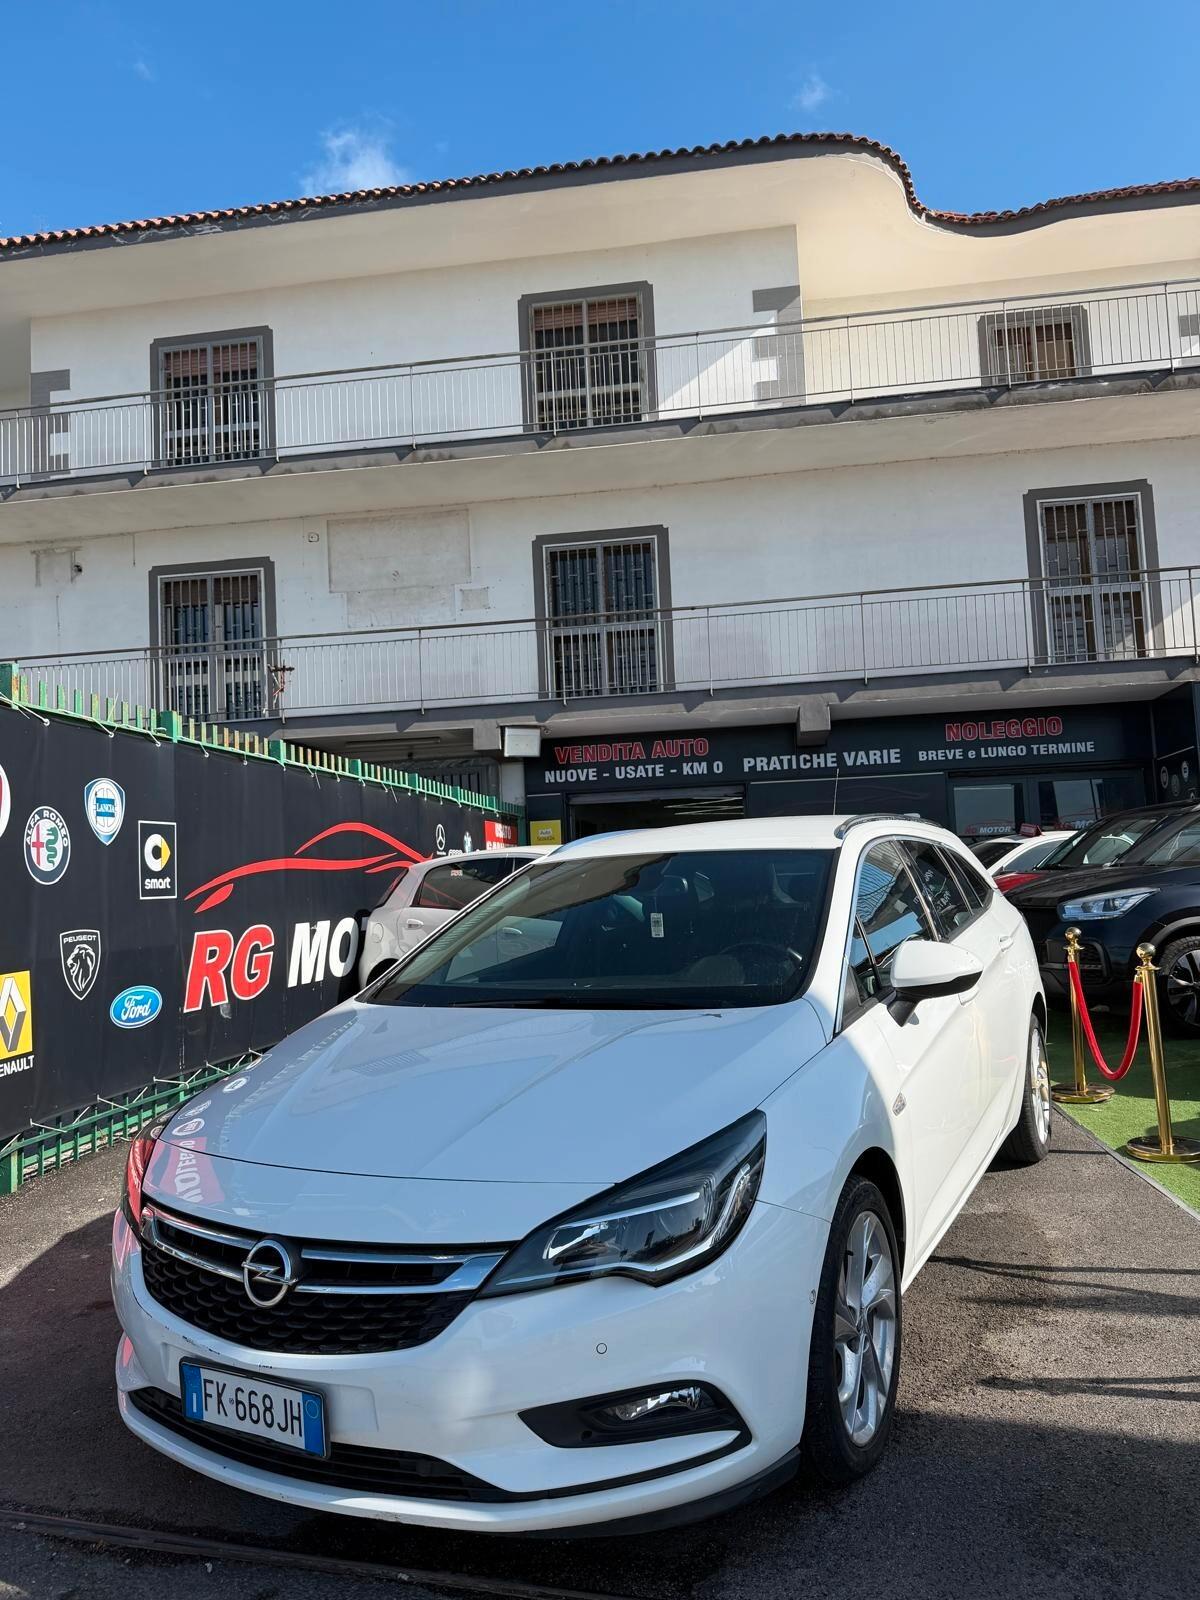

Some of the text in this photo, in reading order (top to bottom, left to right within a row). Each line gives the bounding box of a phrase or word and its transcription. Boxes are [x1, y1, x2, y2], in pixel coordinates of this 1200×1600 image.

[945, 716, 1063, 742] NOLEGGIO
[554, 737, 709, 765] VENDITA AUTO
[743, 748, 901, 773] PRATICHE VARIE
[918, 741, 1096, 762] BREVE e LUNGO TERMINE
[544, 768, 598, 784] NUOVE
[614, 764, 665, 780] USATE
[682, 761, 707, 776] KM
[96, 803, 116, 813] LANCIA
[26, 809, 69, 848] ALFA ROMEO
[494, 822, 512, 840] USATO
[979, 825, 1012, 834] MOTOR
[144, 876, 171, 890] smart
[63, 934, 97, 944] PEUGEOT
[183, 924, 275, 1014] RG
[120, 994, 153, 1021] Ford
[203, 1378, 303, 1437] FK 668JH
